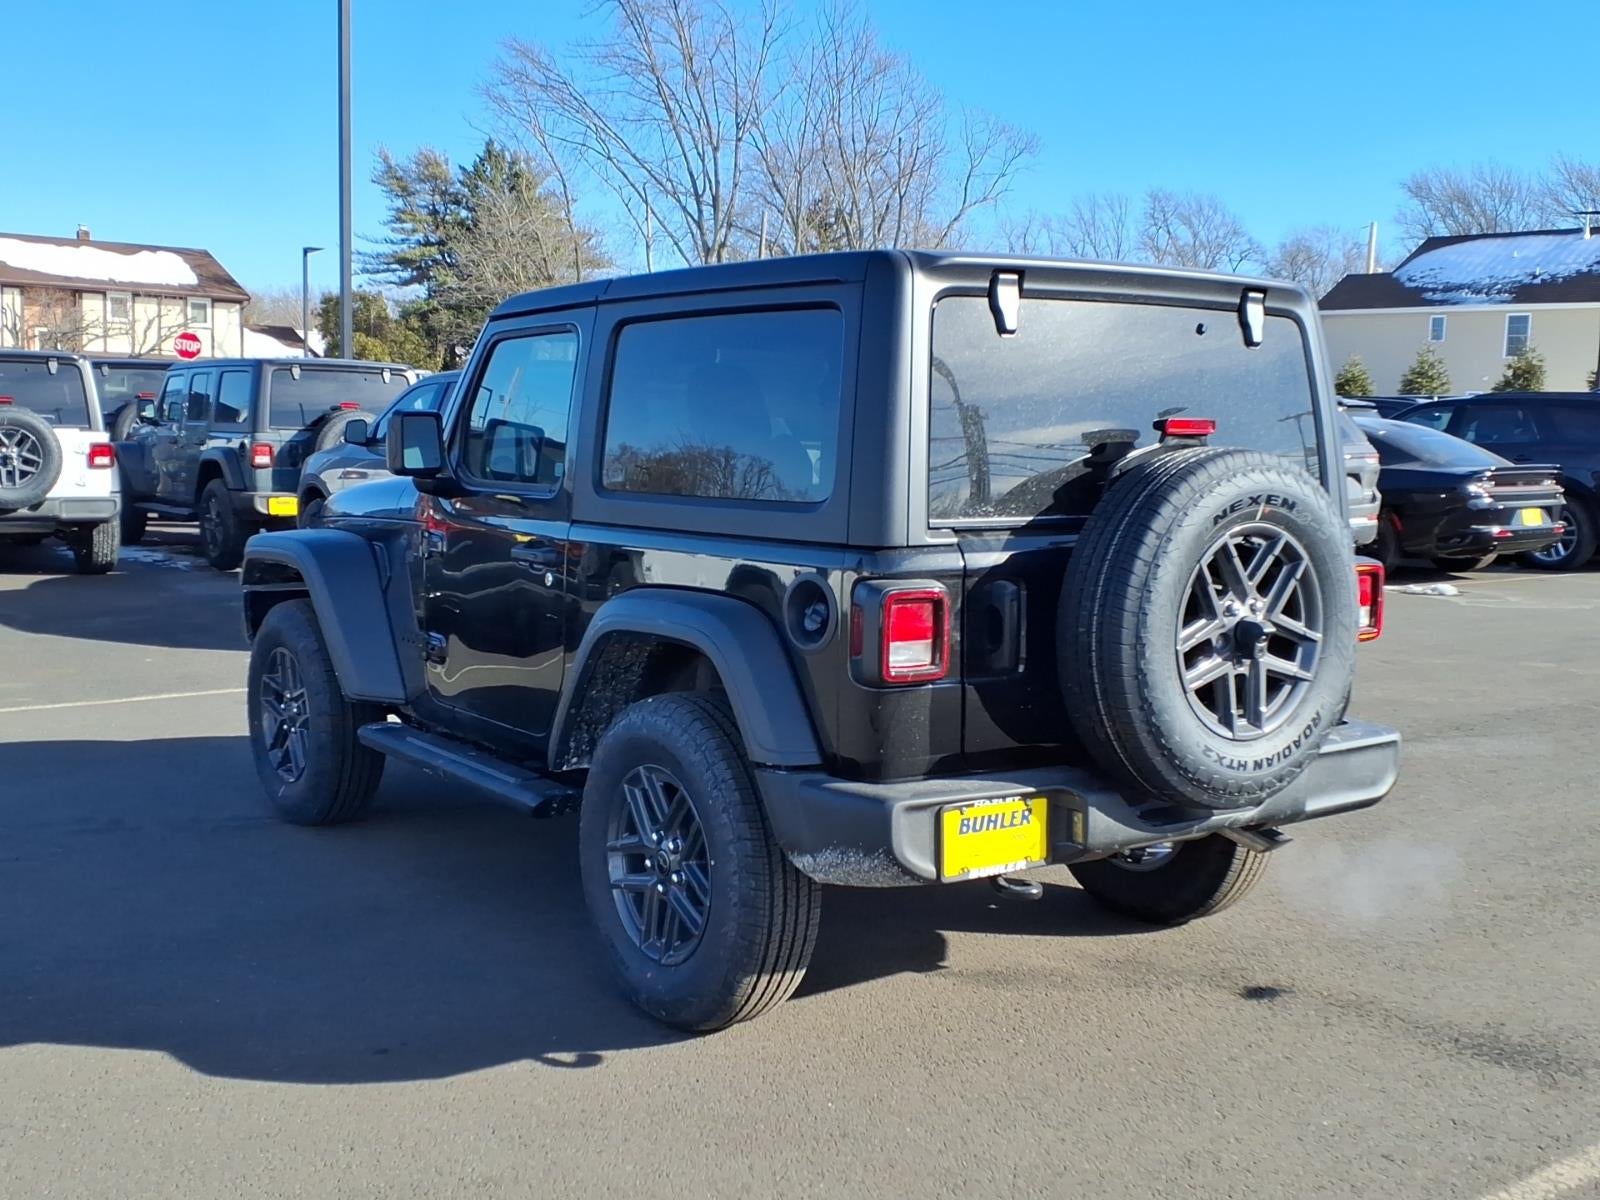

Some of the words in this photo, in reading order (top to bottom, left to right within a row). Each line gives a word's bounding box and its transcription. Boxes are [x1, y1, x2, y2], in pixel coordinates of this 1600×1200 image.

[175, 338, 201, 353] STOP
[1213, 494, 1296, 526] NEXEN
[1252, 710, 1321, 772] ROADIAN
[1202, 744, 1248, 771] HTX2
[959, 808, 1031, 835] BUHLER
